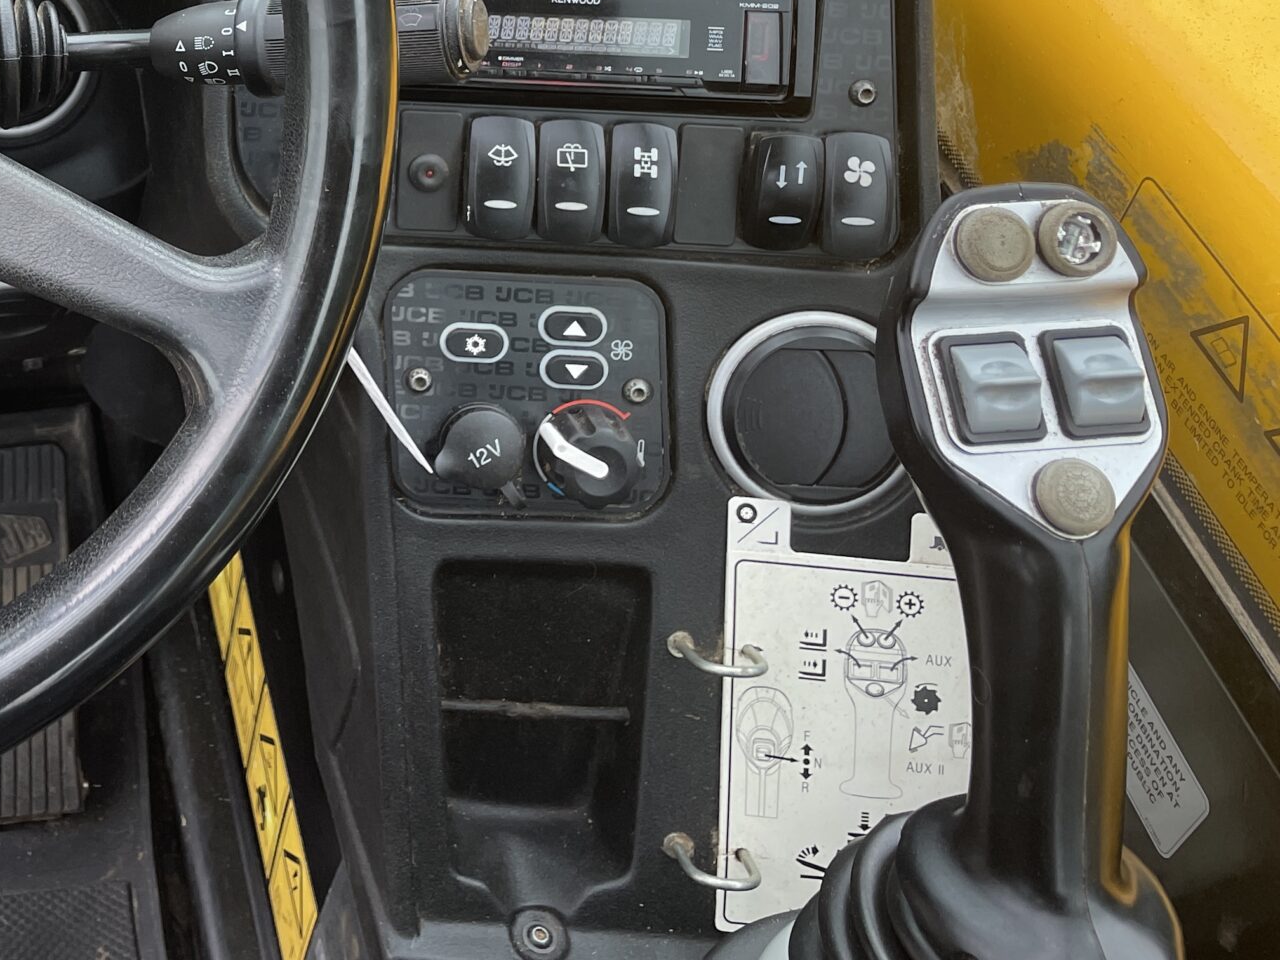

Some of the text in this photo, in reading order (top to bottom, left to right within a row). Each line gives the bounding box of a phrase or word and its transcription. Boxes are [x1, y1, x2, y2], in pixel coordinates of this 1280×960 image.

[1161, 354, 1176, 374] AIR
[1177, 376, 1197, 402] AND
[1199, 402, 1231, 448] ENGINE
[467, 438, 501, 469] 12V
[1165, 374, 1211, 439] EXTENDED
[1212, 439, 1244, 485] CRANK
[1246, 487, 1272, 521] TIME
[1170, 399, 1278, 550] BE LIMITED TO IDLE FOR
[1, 520, 47, 557] JCB
[925, 655, 952, 667] AUX
[803, 730, 811, 740] F
[1128, 703, 1181, 798] OMBINATION.
[1147, 721, 1167, 750] AND
[1166, 755, 1186, 783] ANY
[814, 759, 822, 768] N
[906, 762, 932, 775] AUX
[1136, 733, 1180, 809] DRIVEN AT
[801, 783, 809, 793] R
[1151, 781, 1165, 800] OF
